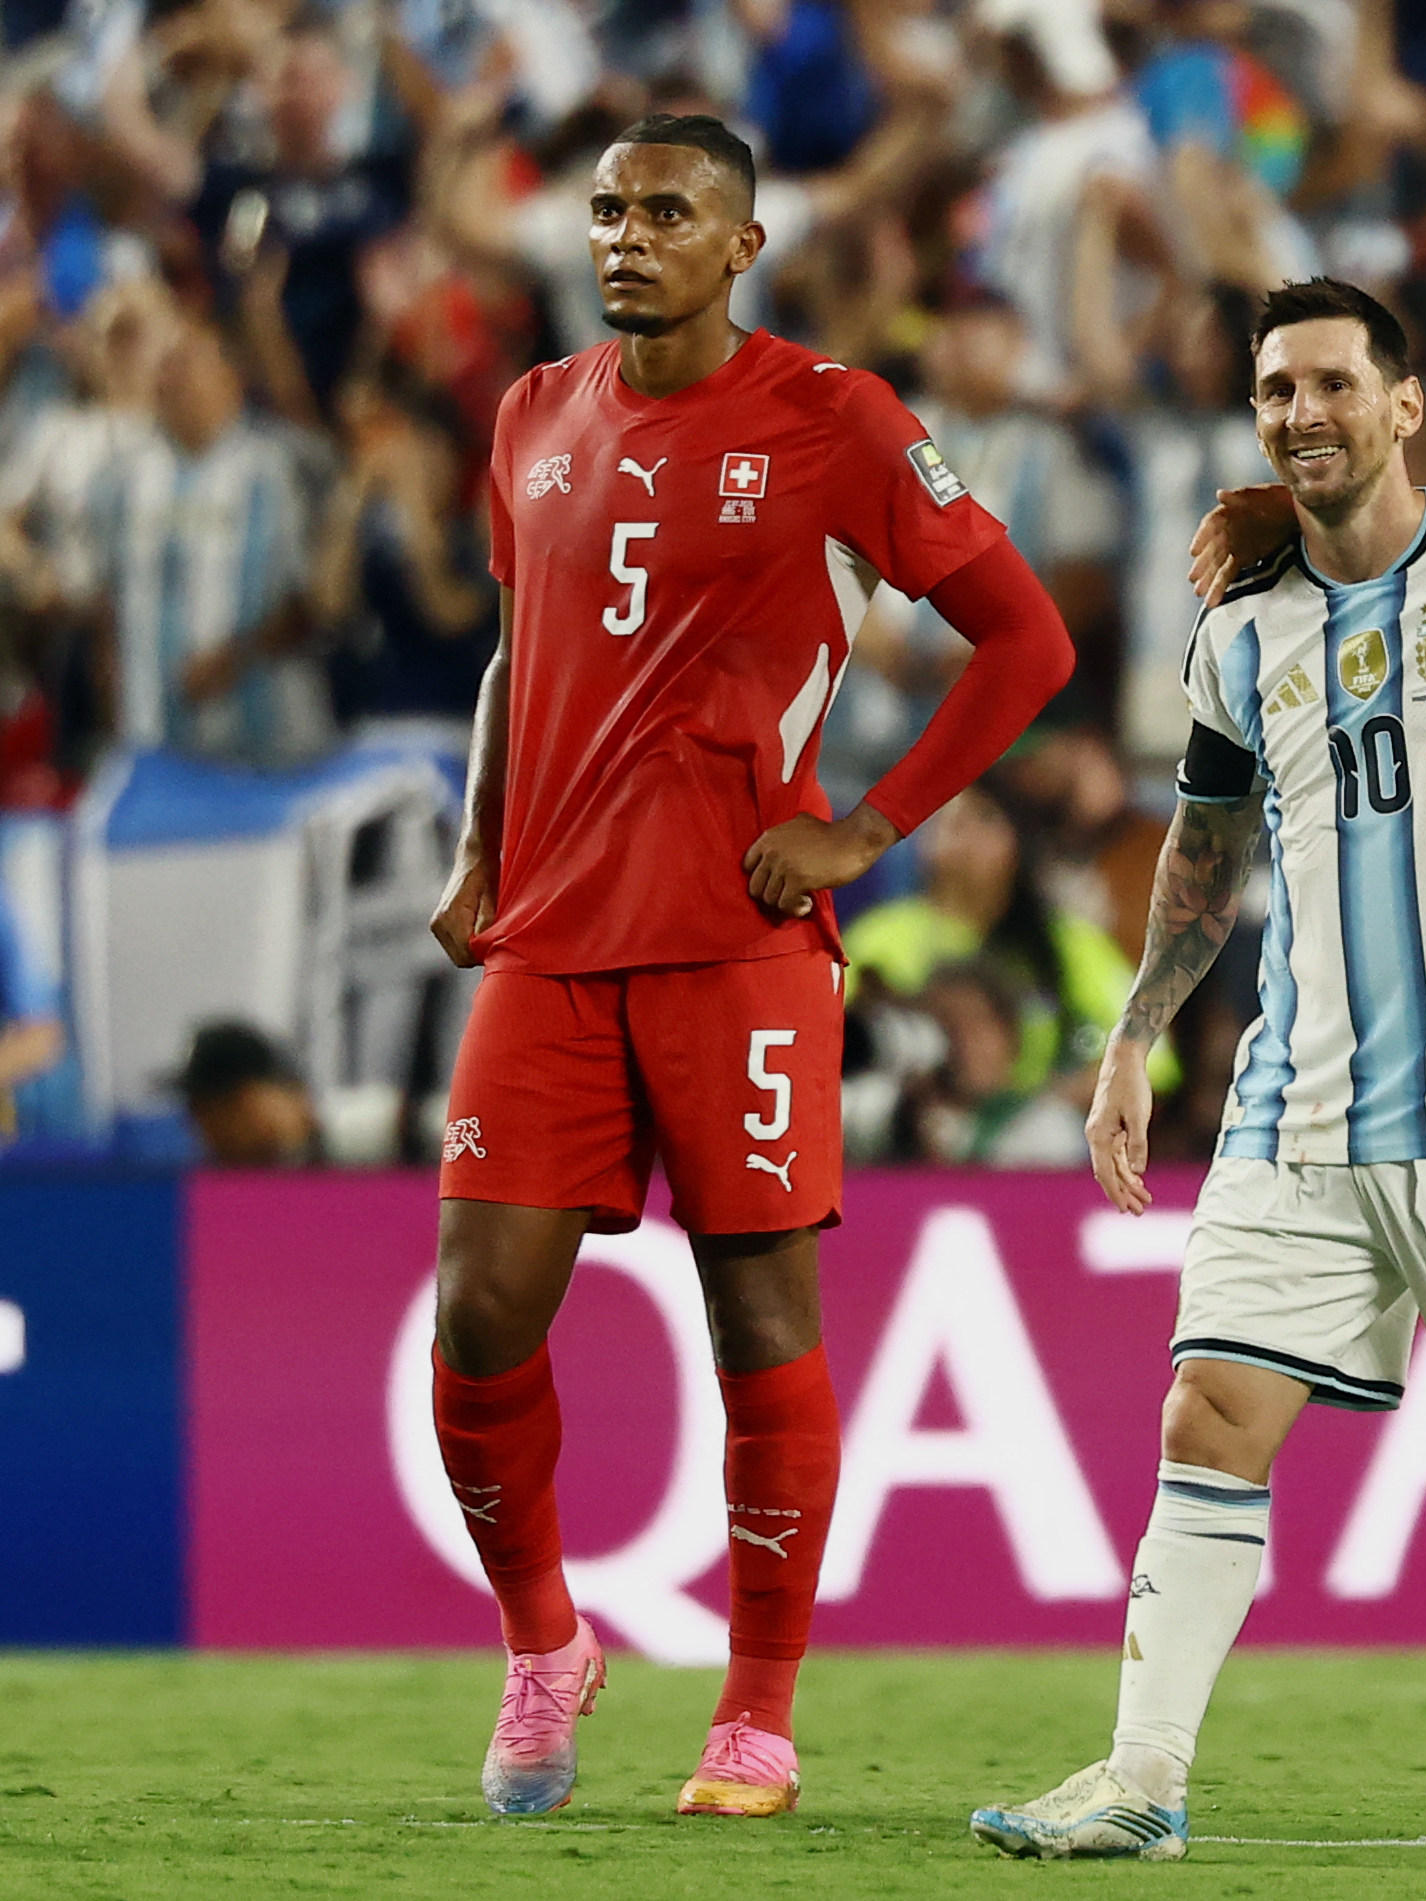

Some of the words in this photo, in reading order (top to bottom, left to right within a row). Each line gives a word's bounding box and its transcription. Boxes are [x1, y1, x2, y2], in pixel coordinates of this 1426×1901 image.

[602, 522, 660, 636] 5
[1328, 714, 1413, 821] 10
[744, 1029, 798, 1141] 5
